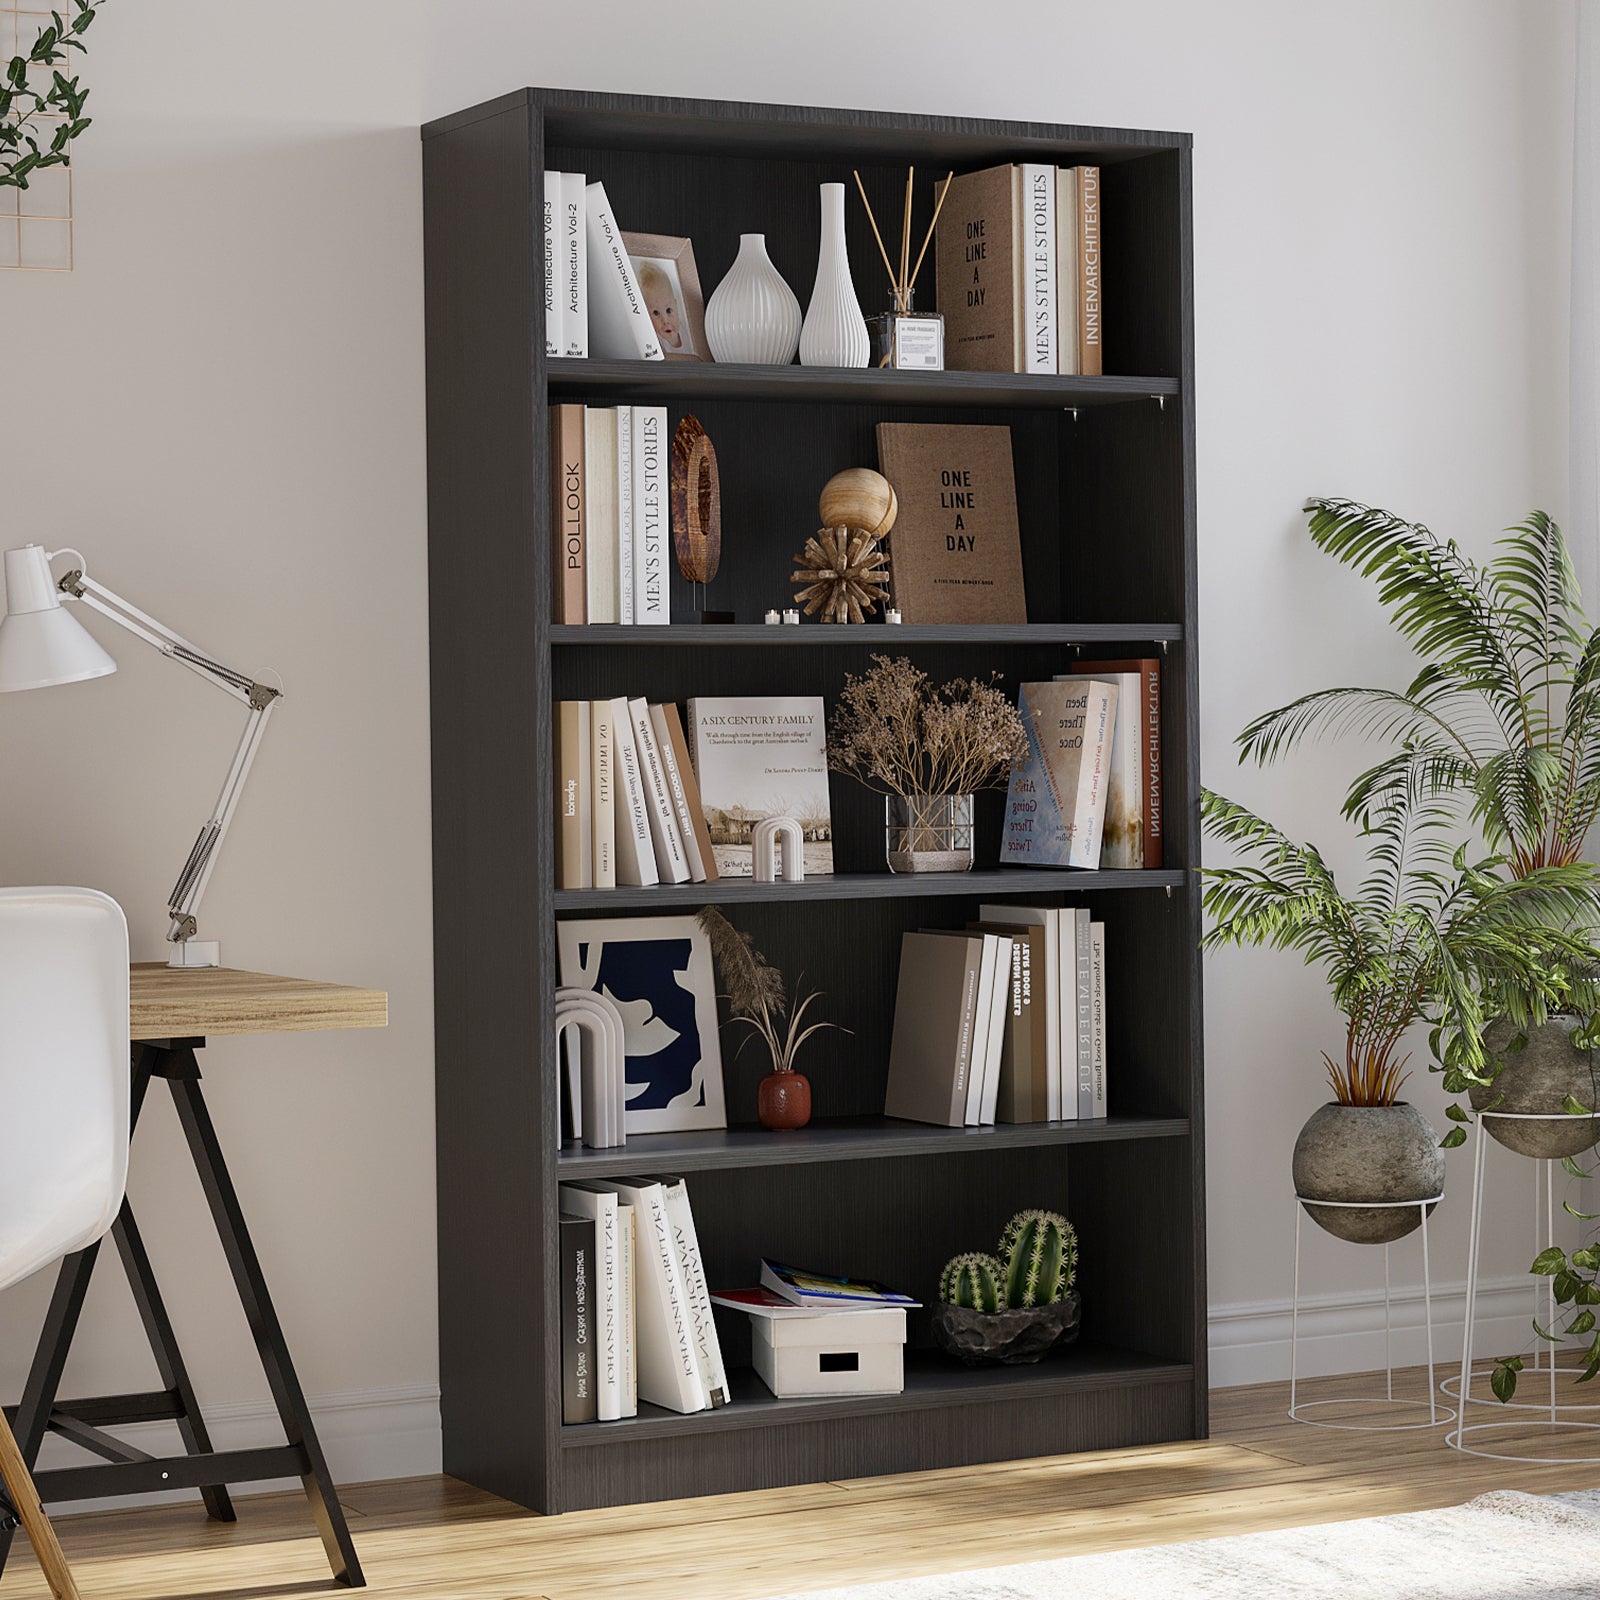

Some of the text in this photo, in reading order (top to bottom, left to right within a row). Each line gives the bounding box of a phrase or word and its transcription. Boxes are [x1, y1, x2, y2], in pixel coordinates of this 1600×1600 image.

[967, 220, 985, 240] ONE
[568, 203, 578, 314] Architecture Vol-2
[966, 242, 986, 263] LINE
[1084, 167, 1098, 345] INNENARCHITEKTUR
[598, 213, 640, 315] Architecture Vol-1
[1034, 174, 1049, 365] MEN'S STYLE STORIES
[973, 266, 980, 284] A
[967, 288, 986, 307] DAY
[941, 470, 971, 487] ONE
[941, 492, 975, 509] LINE
[566, 462, 581, 569] POLLOCK
[644, 416, 660, 612] MEN'S STYLE STORIES
[955, 514, 964, 530] A
[946, 536, 976, 552] DAY
[701, 715, 814, 725] A SIX CENTURY FAMILY
[605, 1207, 615, 1386] JOHANNES GRÜTZKE
[667, 1286, 694, 1377] JOHANNES
